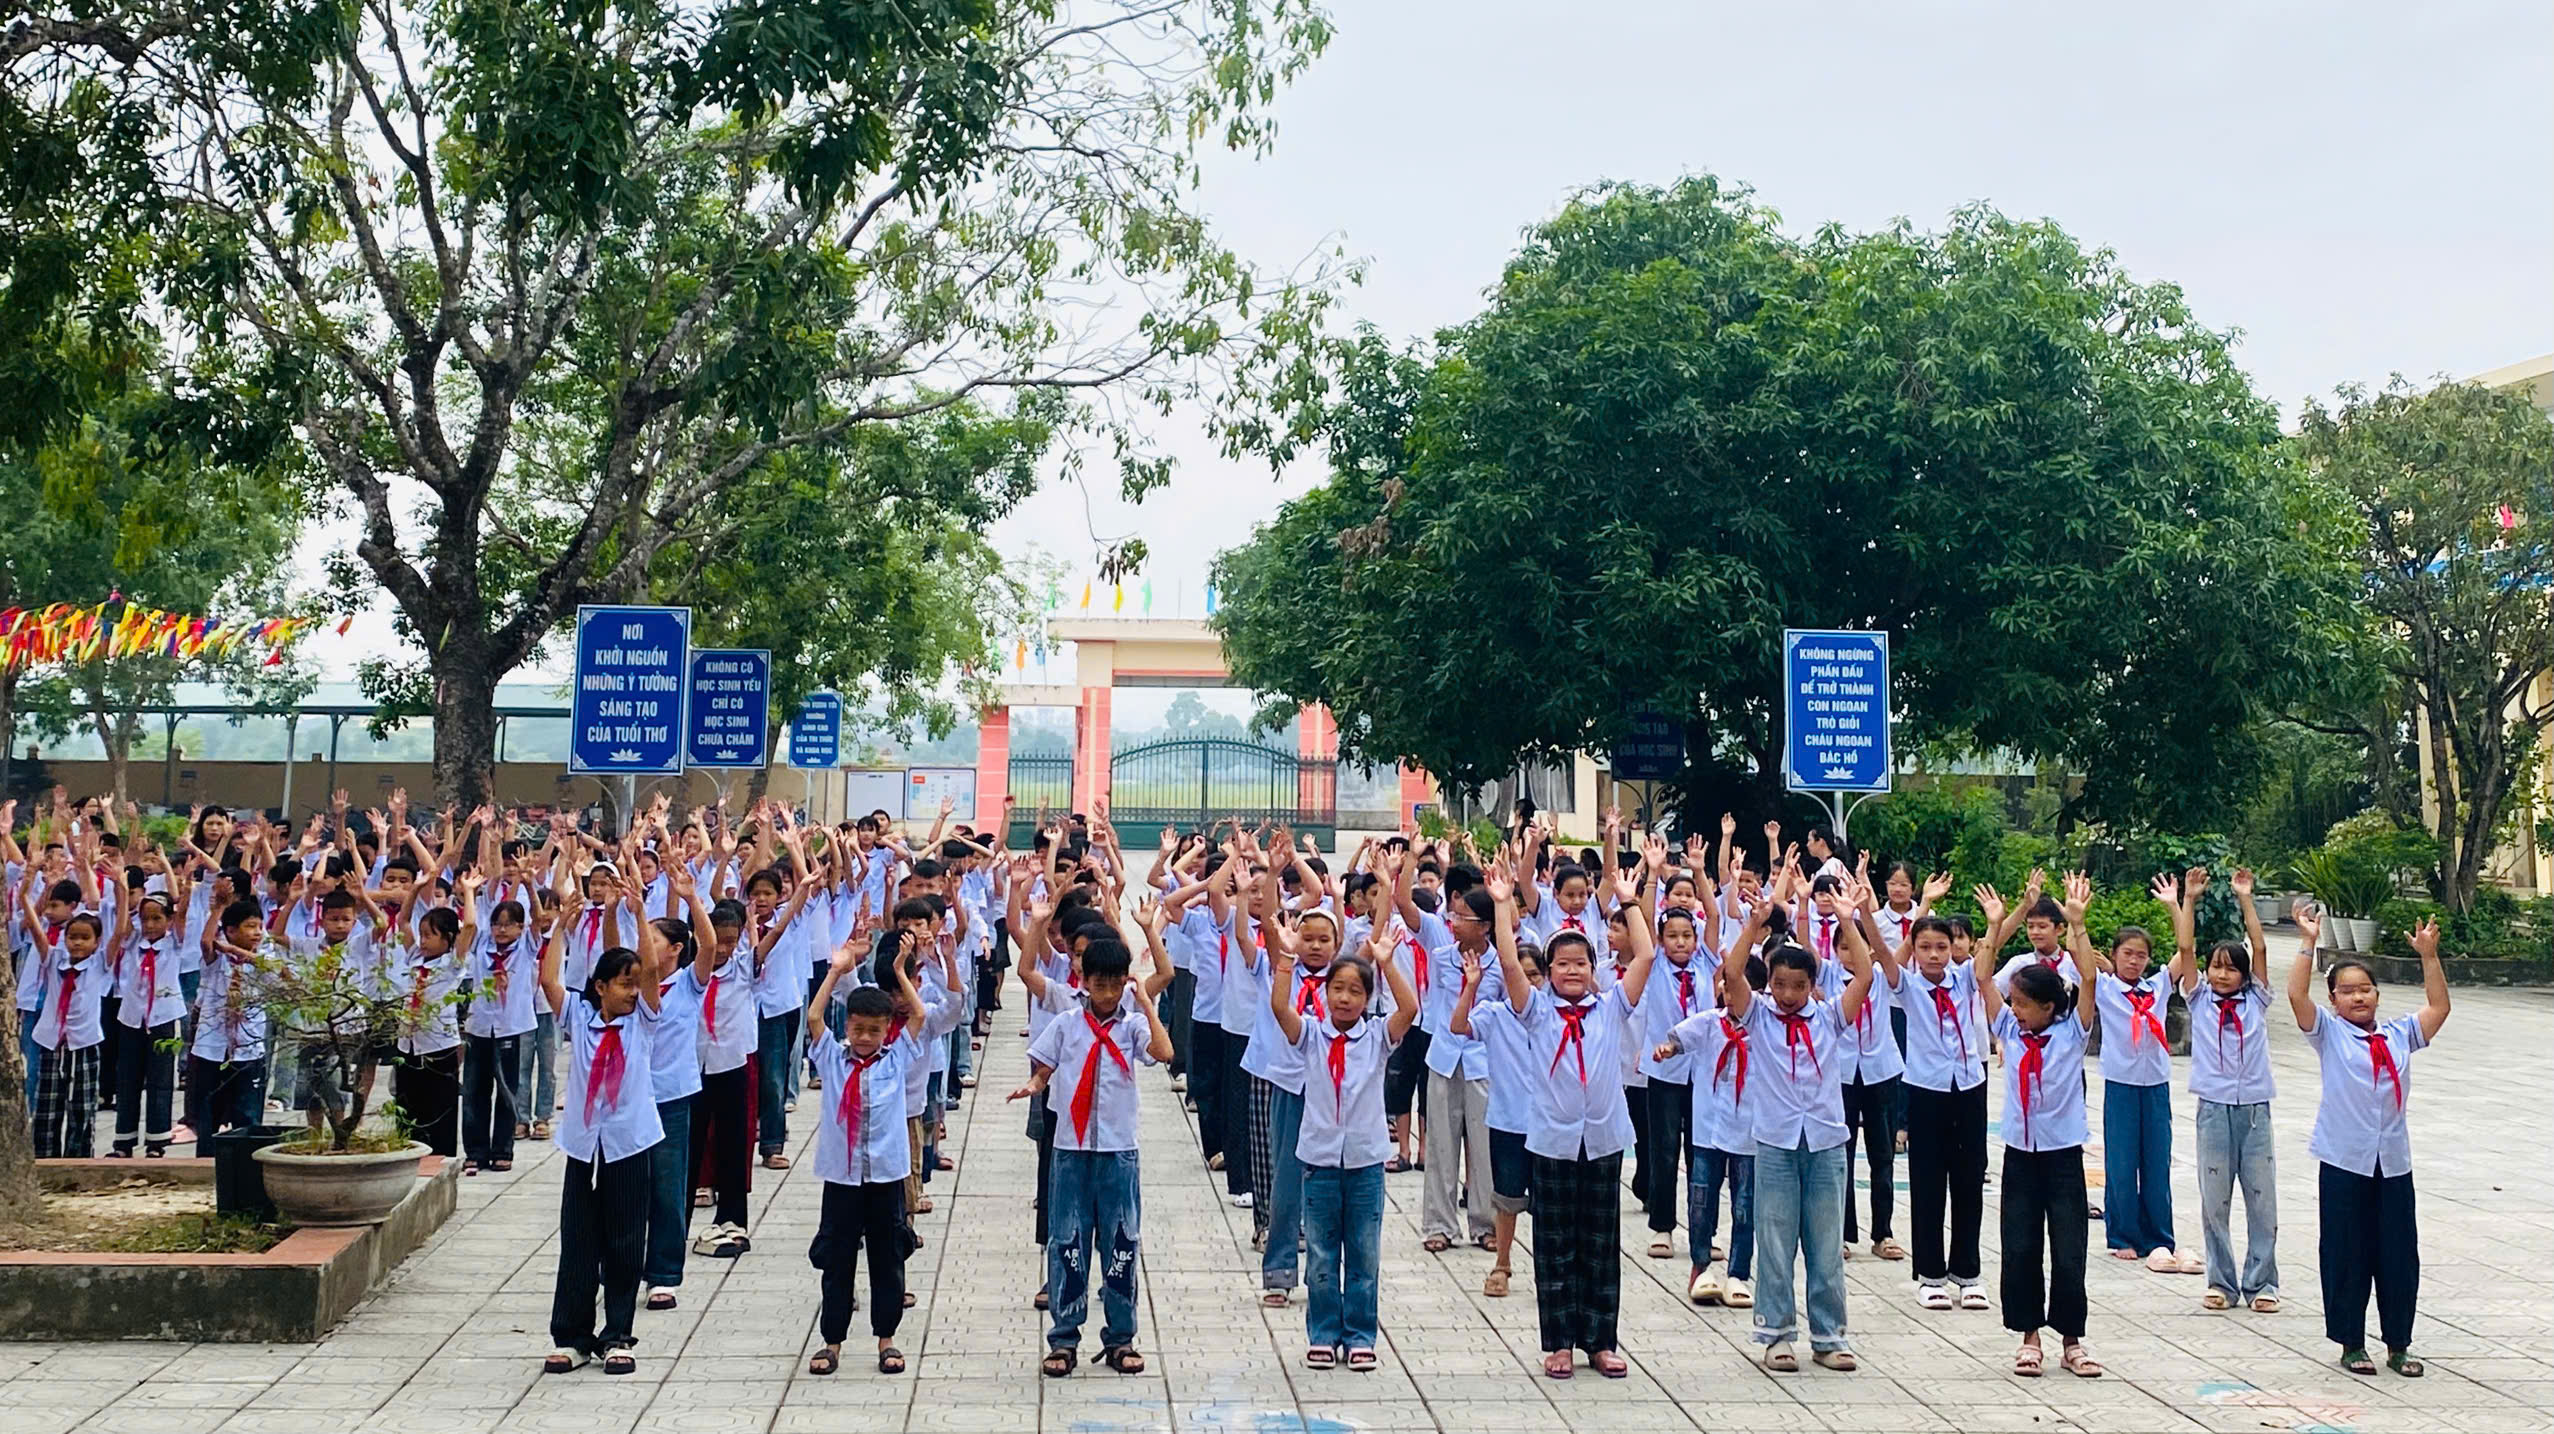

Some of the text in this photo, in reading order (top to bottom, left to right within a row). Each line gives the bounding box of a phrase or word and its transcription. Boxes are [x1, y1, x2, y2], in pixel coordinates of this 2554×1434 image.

[622, 623, 643, 641] NƠI
[595, 644, 624, 665] KHỞI
[1799, 646, 1835, 660] KHÔNG
[705, 660, 753, 673] KHÔNG CÓ
[1810, 662, 1840, 678] PHẤN
[583, 671, 677, 691] NHỮNG Ý TƯỞNG
[696, 677, 761, 693] HỌC SINH YẾU
[1817, 681, 1837, 695] TRỞ
[1840, 681, 1874, 695] THÀNH
[599, 698, 658, 720] SÁNG TẠO
[711, 694, 744, 709] CHỈ CÓ
[1807, 700, 1868, 712] CON NGOAN
[704, 716, 749, 729] HỌC SINH
[1816, 714, 1860, 730] TRÒ GIỎI
[587, 721, 668, 743] CỦA TUỔI THƠ
[697, 733, 724, 745] CHƯA
[1805, 733, 1872, 747] CHÁU NGOAN
[1820, 750, 1841, 764] BÁC
